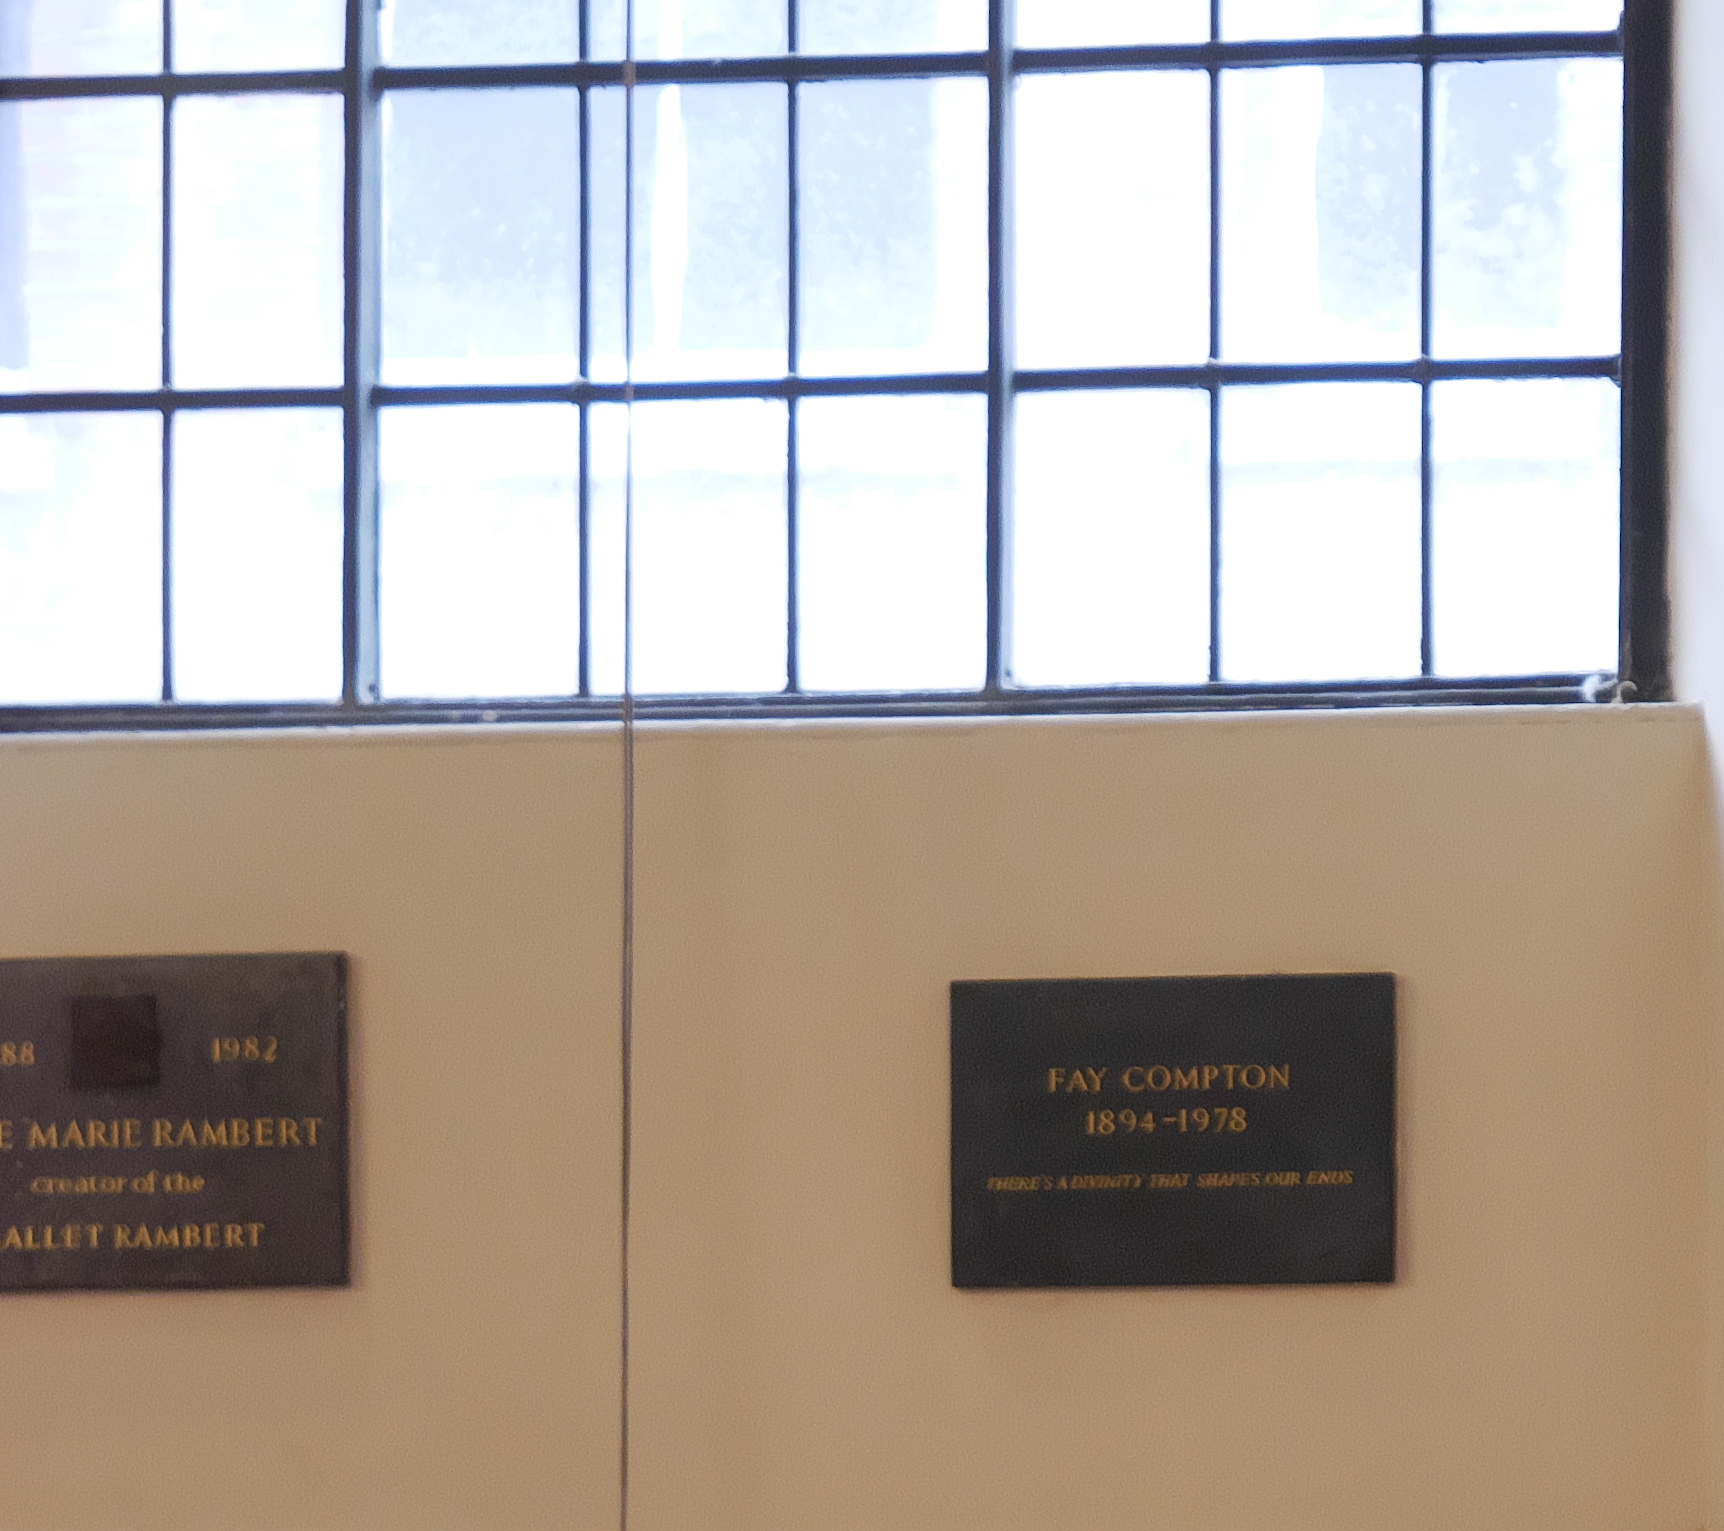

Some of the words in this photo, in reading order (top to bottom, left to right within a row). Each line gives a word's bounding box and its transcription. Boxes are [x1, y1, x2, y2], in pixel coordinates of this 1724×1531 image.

[211, 1035, 279, 1064] 1982
[1047, 1066, 1107, 1093] FAY
[1121, 1063, 1291, 1092] COMPTON
[29, 1118, 142, 1149] MARIE
[153, 1117, 322, 1147] RAMBERT
[30, 1176, 128, 1194] creator
[130, 1169, 158, 1194] of
[162, 1171, 205, 1194] the
[1058, 1175, 1068, 1190] A
[1150, 1172, 1191, 1188] THAT
[1197, 1171, 1261, 1188] SHAPES
[1264, 1171, 1301, 1187] OUR
[1306, 1170, 1354, 1185] ENDS
[0, 1223, 103, 1249] ALLET
[114, 1222, 265, 1249] RAMBERT
